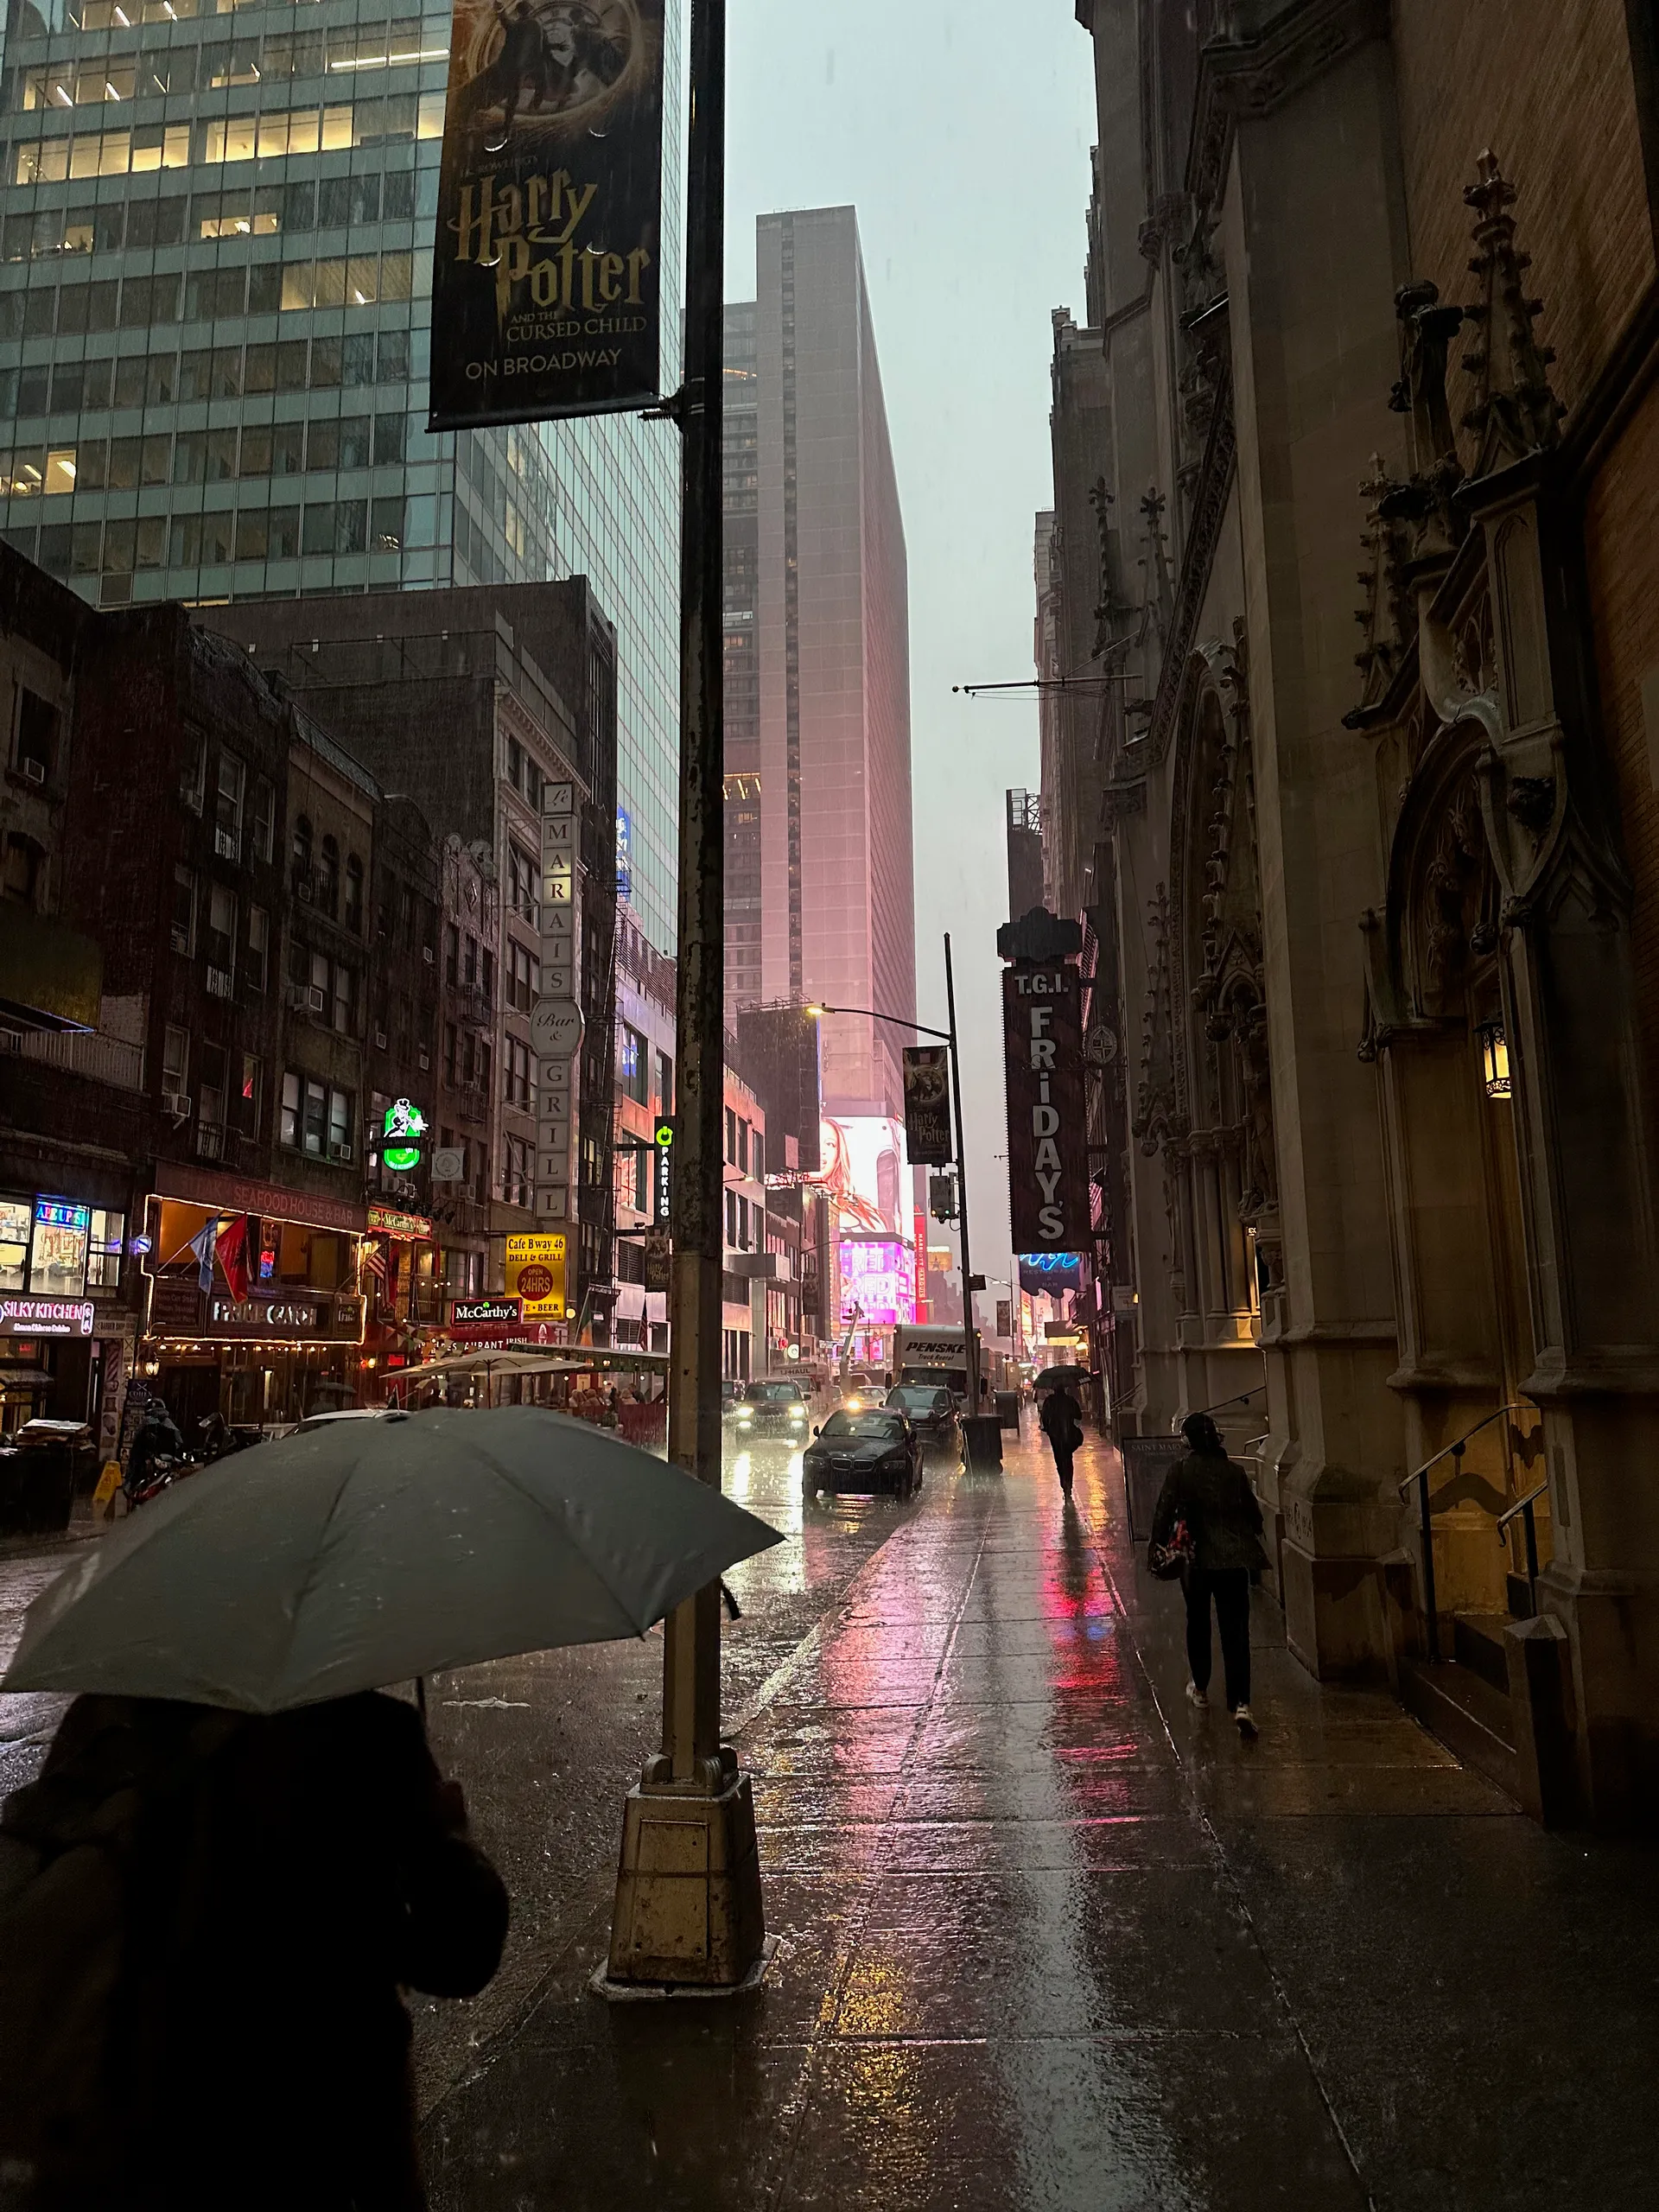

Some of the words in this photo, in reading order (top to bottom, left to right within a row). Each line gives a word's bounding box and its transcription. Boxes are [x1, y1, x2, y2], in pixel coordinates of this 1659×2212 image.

[447, 168, 598, 264] Harry
[493, 233, 651, 342] Potter
[512, 313, 535, 323] AND
[506, 321, 581, 343] CURSED
[584, 315, 647, 336] CHILD
[465, 360, 498, 380] ON
[503, 347, 622, 376] BROADWAY
[550, 788, 570, 805] Le
[548, 823, 569, 988] MARAIS
[1014, 973, 1069, 995] T.G.I.
[537, 1014, 576, 1028] Bar
[550, 1032, 563, 1042] &
[907, 1112, 938, 1132] Harry
[545, 1065, 563, 1211] GRILL
[918, 1126, 950, 1147] Potter
[660, 1146, 670, 1217] PARKING
[233, 1185, 289, 1211] SEAFOOD
[291, 1198, 323, 1219] HOUSE
[334, 1210, 353, 1224] BAR
[554, 1238, 564, 1249] 46
[520, 1277, 550, 1294] 24HRS
[4, 1300, 35, 1319] SILKY
[36, 1302, 83, 1320] KITCHEN
[455, 1305, 518, 1320] McCarthy's
[906, 1342, 967, 1354] PENSKE
[1131, 1444, 1157, 1452] SAINT
